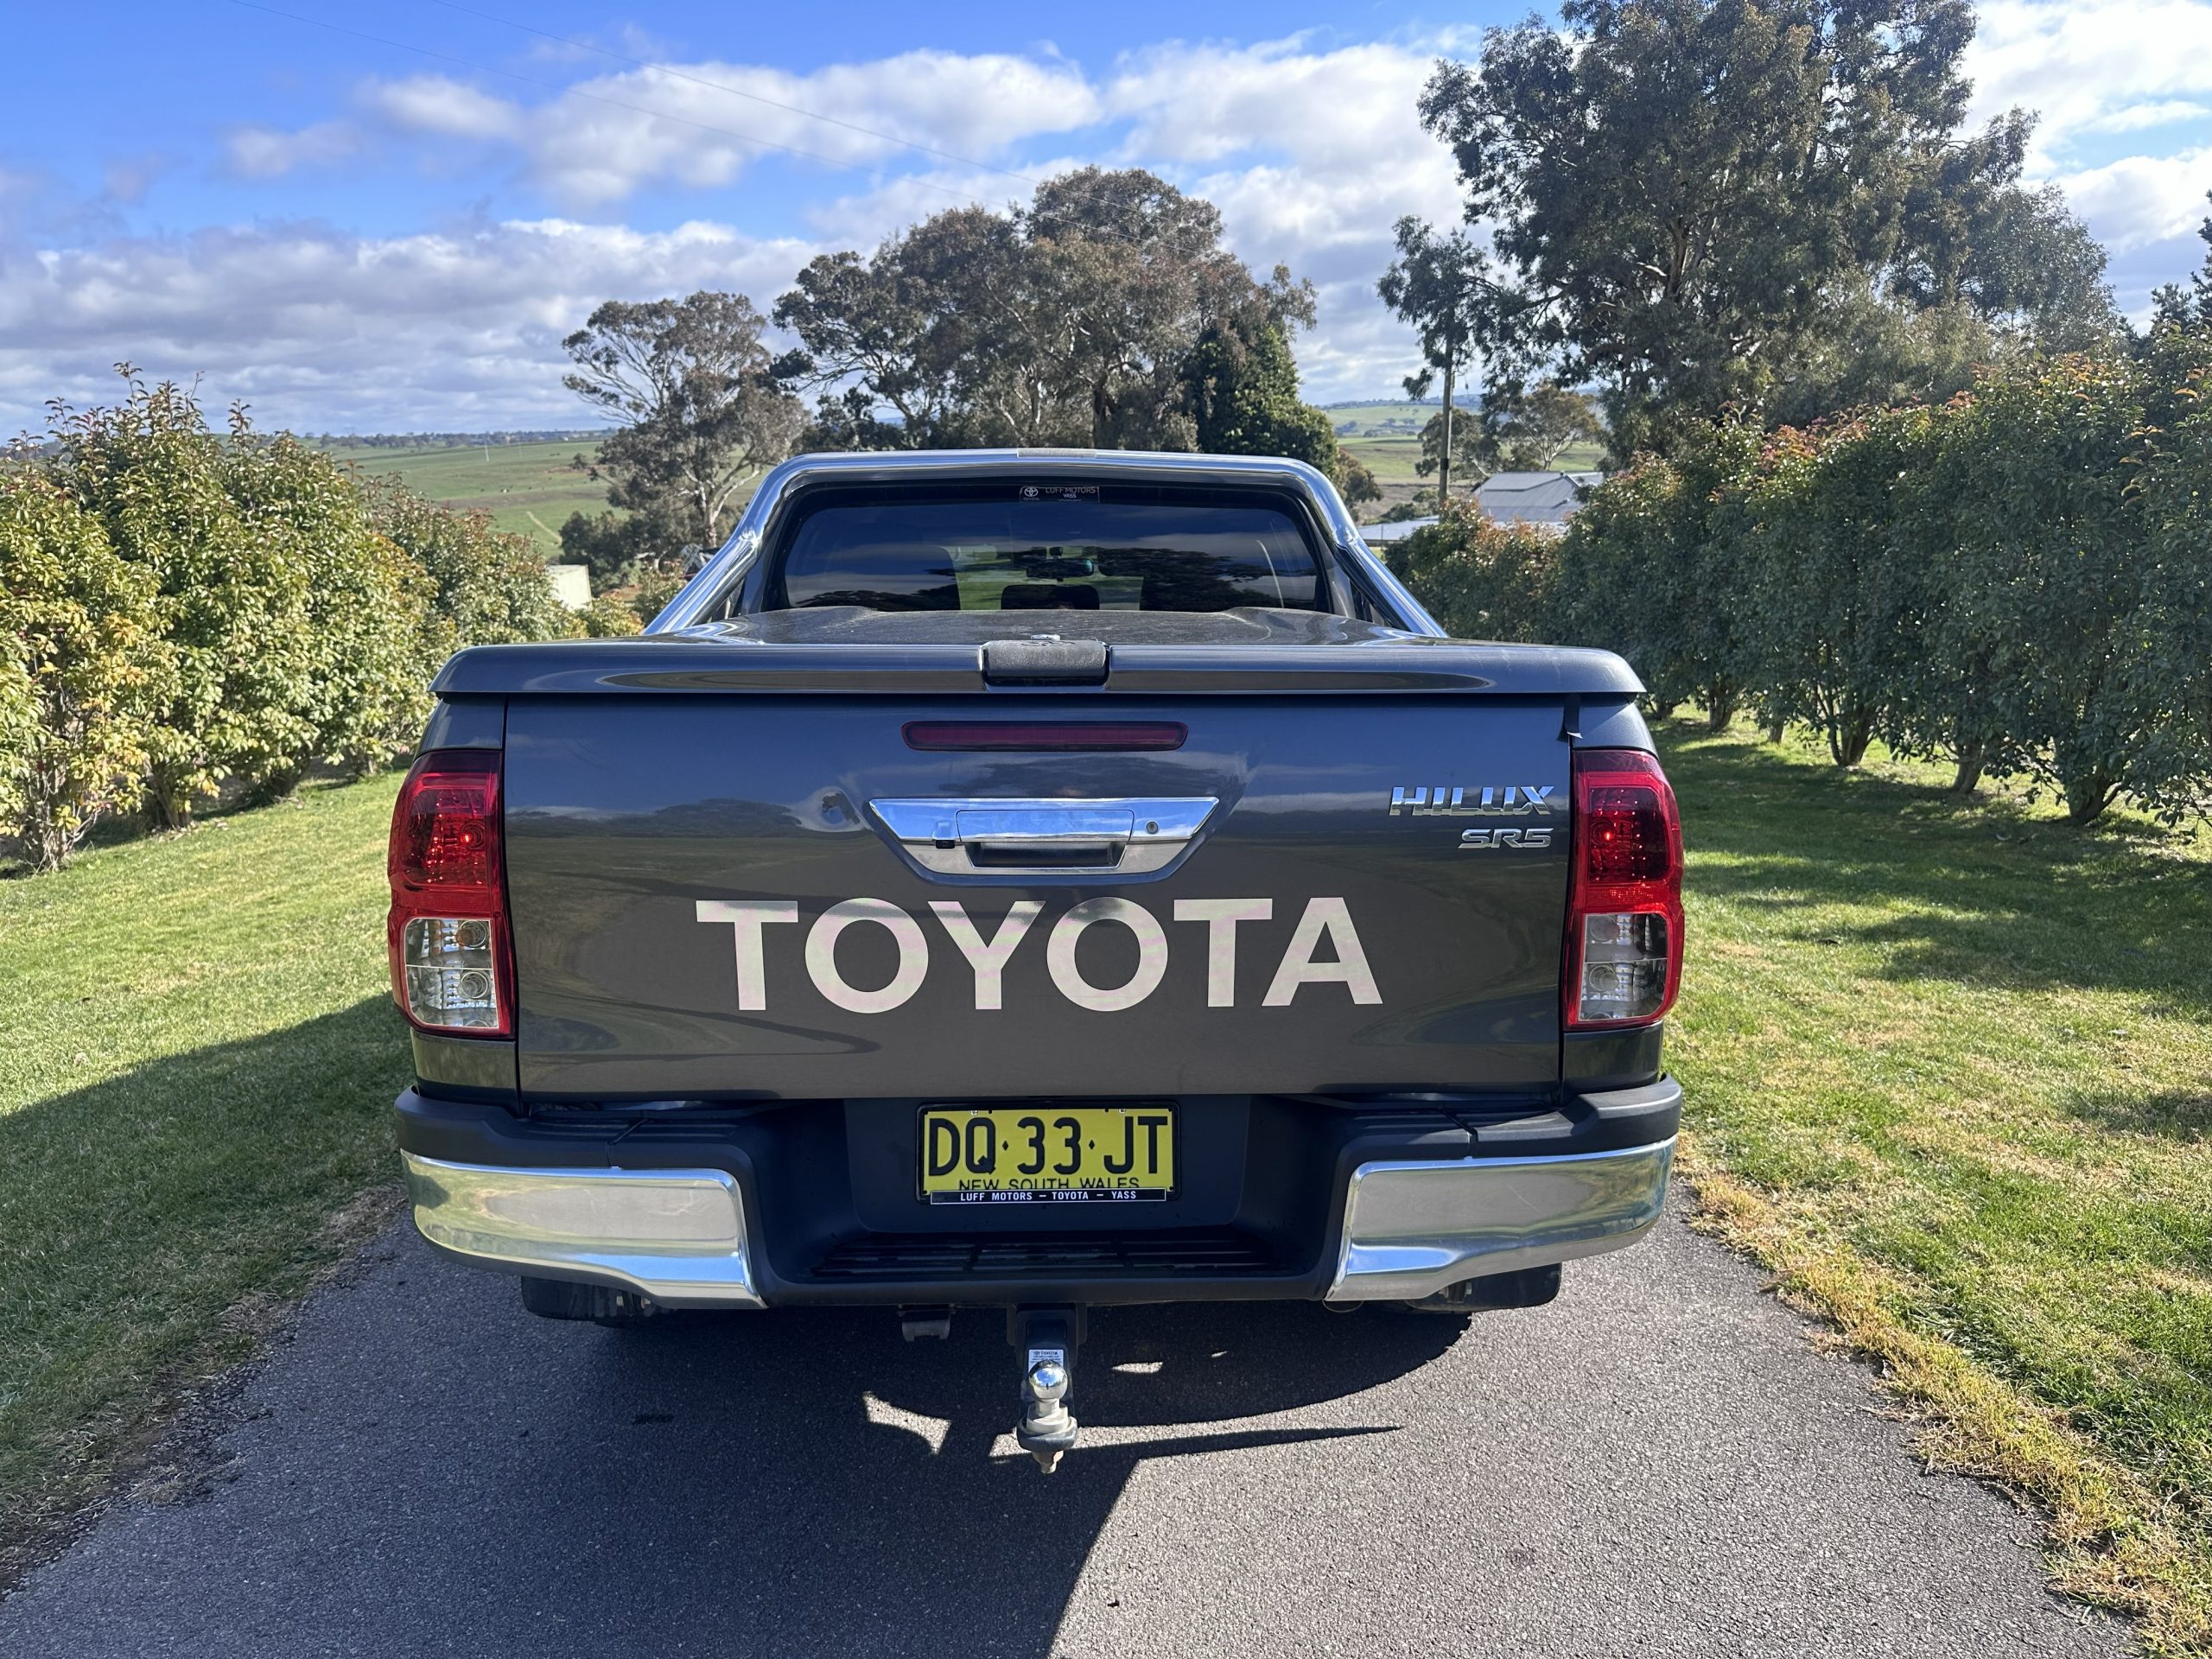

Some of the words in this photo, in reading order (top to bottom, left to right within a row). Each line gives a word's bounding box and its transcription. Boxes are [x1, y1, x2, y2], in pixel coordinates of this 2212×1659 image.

[1389, 785, 1554, 816] HILUX
[1459, 828, 1554, 849] SR5
[696, 896, 1383, 1014] TOYOTA
[959, 1179, 999, 1190] NEW
[1008, 1178, 1069, 1190] SOUTH
[1080, 1177, 1140, 1189] WALES
[960, 1192, 985, 1201] LUFF
[991, 1192, 1033, 1201] MOTORS
[1052, 1192, 1089, 1200] TOYOTA
[1111, 1191, 1137, 1199] YASS
